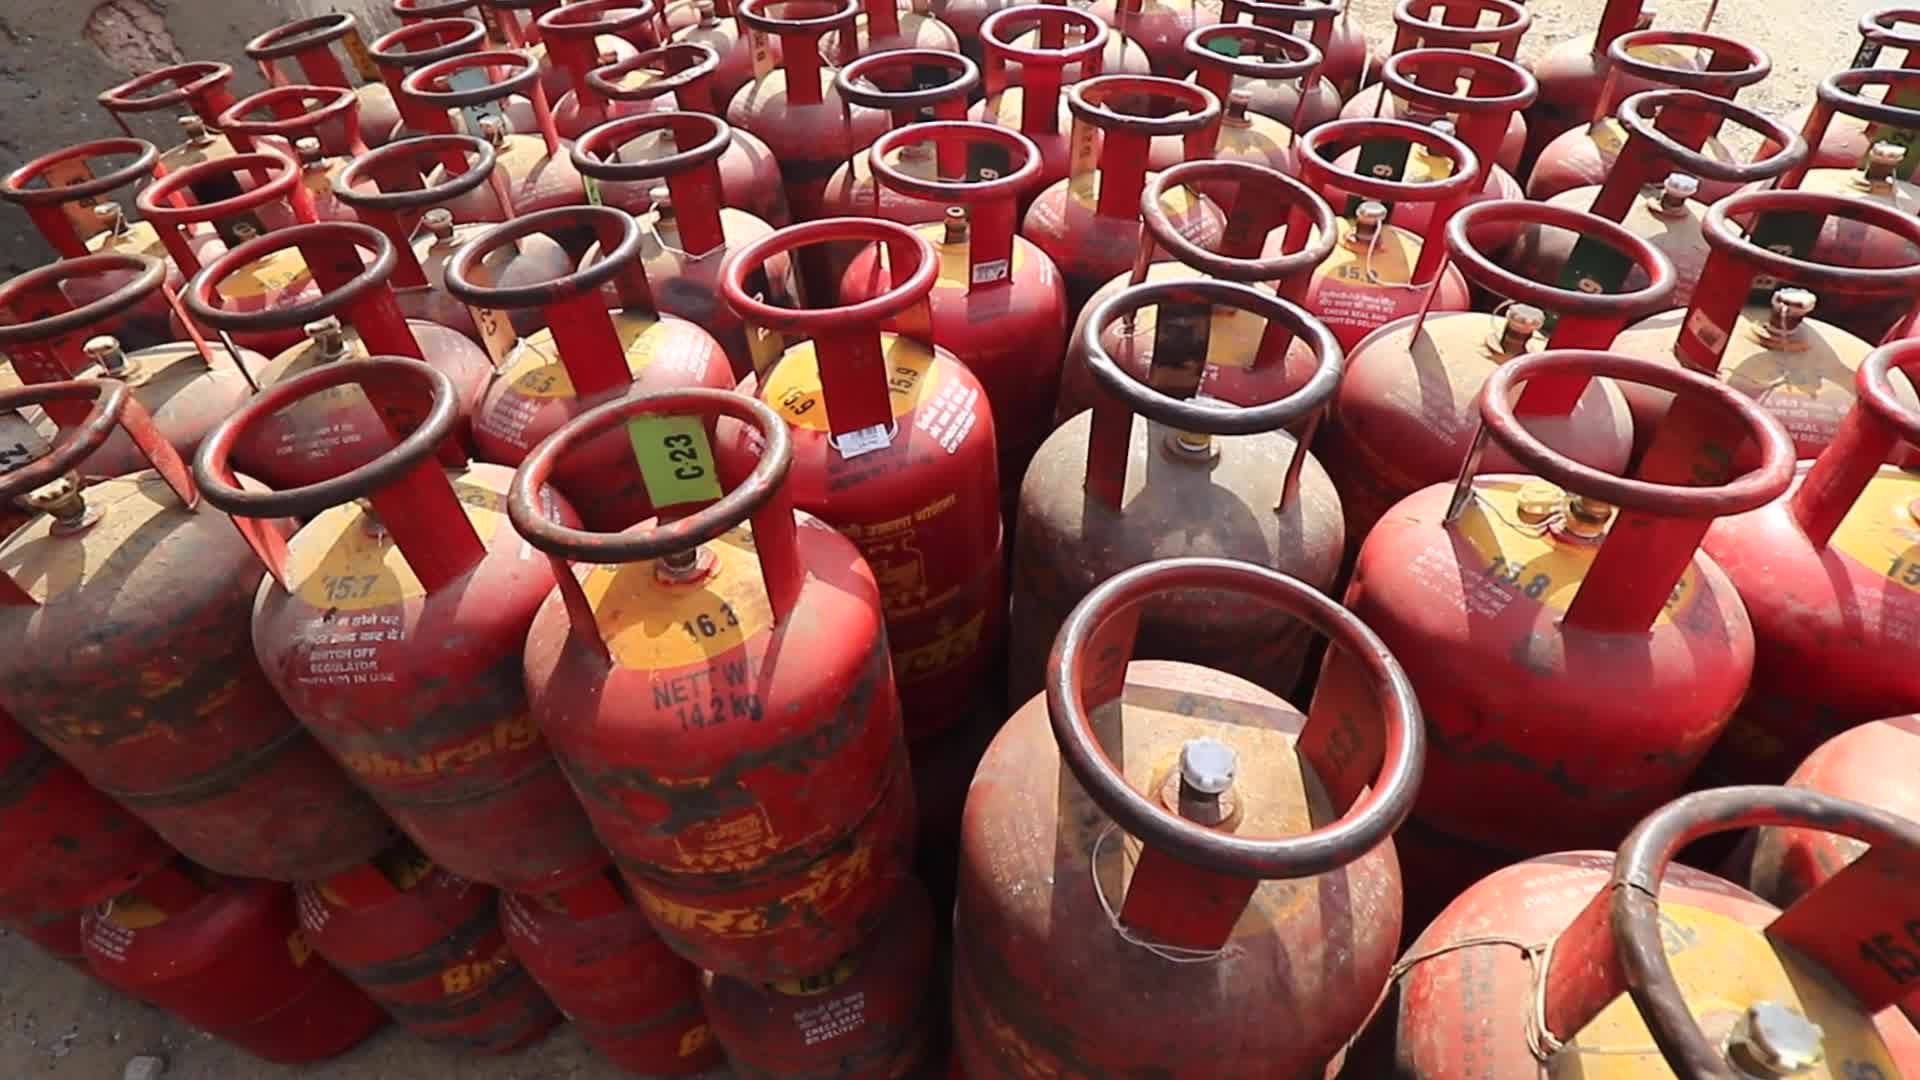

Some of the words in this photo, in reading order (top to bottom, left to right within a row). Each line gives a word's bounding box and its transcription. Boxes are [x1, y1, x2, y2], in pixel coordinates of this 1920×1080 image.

[890, 366, 919, 397] 15.9
[325, 575, 380, 601] 15.7
[1487, 556, 1551, 598] 15.8
[683, 602, 739, 643] 16.3
[353, 646, 377, 659] OFF
[675, 695, 726, 732] 14.2
